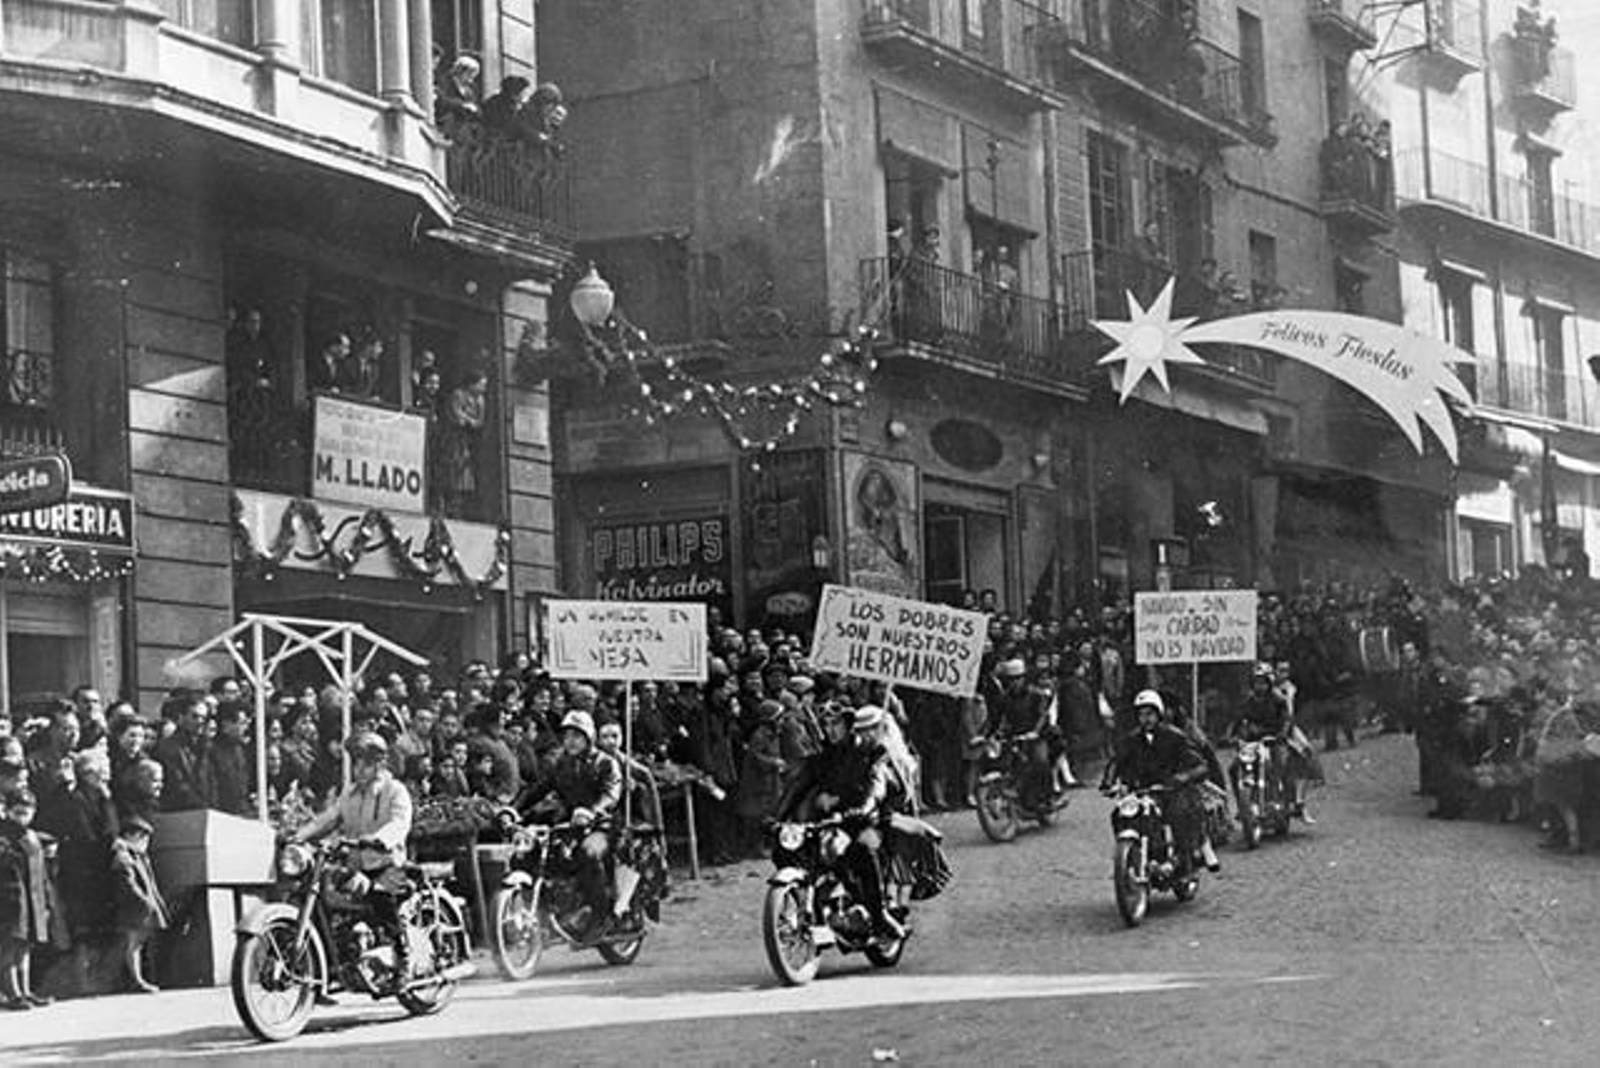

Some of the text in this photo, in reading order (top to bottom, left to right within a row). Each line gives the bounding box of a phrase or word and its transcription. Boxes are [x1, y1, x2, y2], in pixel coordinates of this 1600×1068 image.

[1333, 332, 1414, 380] Fiestas
[316, 454, 420, 496] M. LLADO
[594, 520, 723, 571] PHILIPS
[851, 602, 975, 637] LOS POBRES
[836, 621, 970, 661] SON NUESTROS
[1146, 640, 1166, 658] NO
[850, 644, 960, 686] HERMANOS
